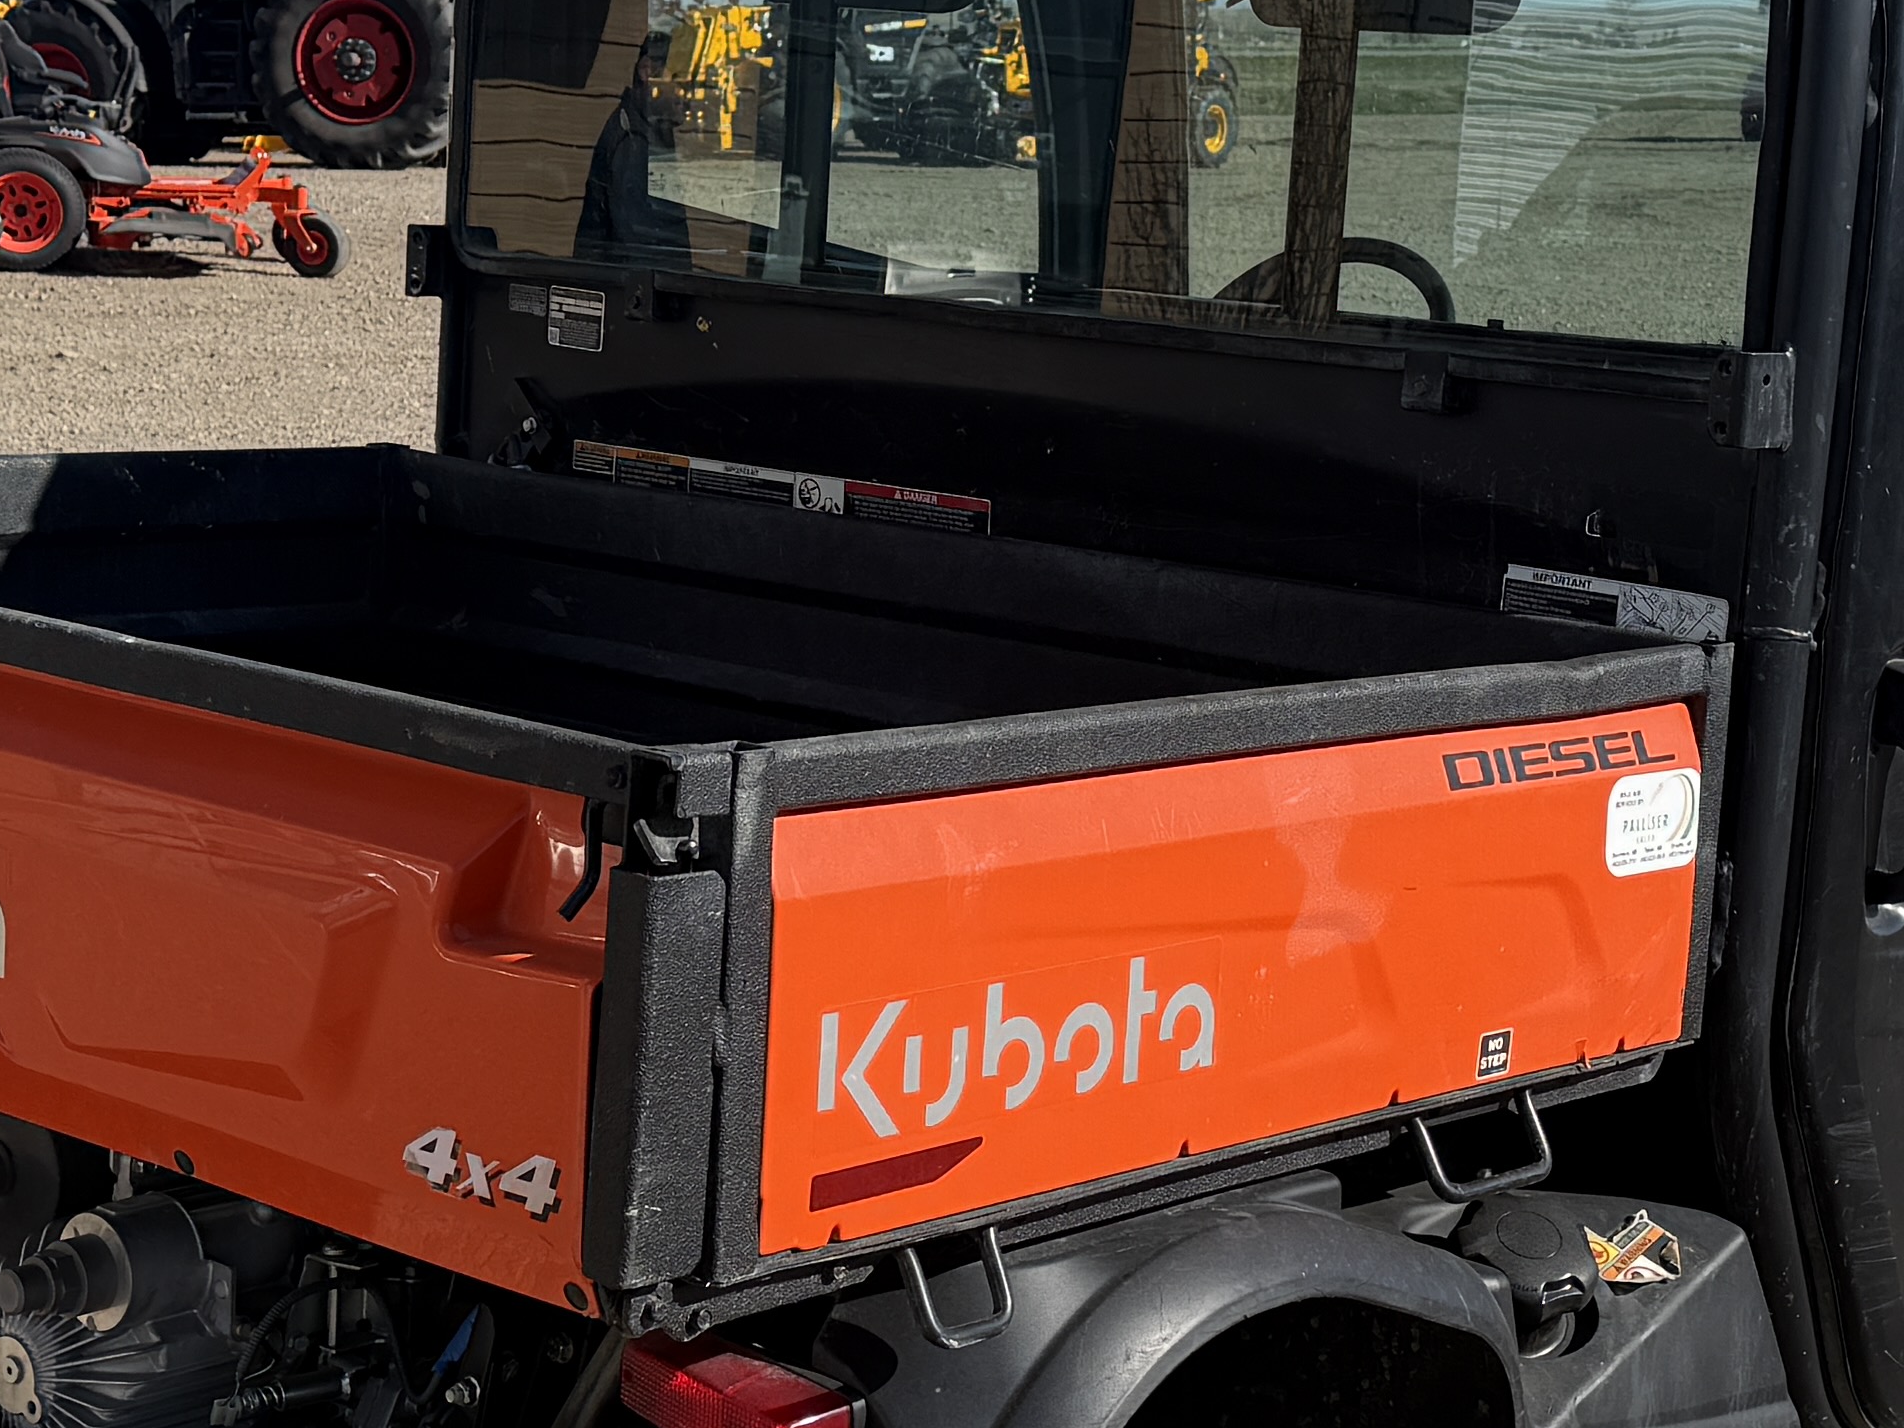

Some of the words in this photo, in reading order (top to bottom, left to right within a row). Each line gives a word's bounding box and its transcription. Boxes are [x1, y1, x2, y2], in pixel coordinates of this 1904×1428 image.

[1532, 571, 1593, 590] IMPORTANT
[1442, 730, 1676, 792] DIESEL
[817, 956, 1215, 1138] Kubota
[1480, 1052, 1507, 1070] STEP
[1488, 1036, 1504, 1052] NO
[402, 1126, 562, 1223] 4x4
